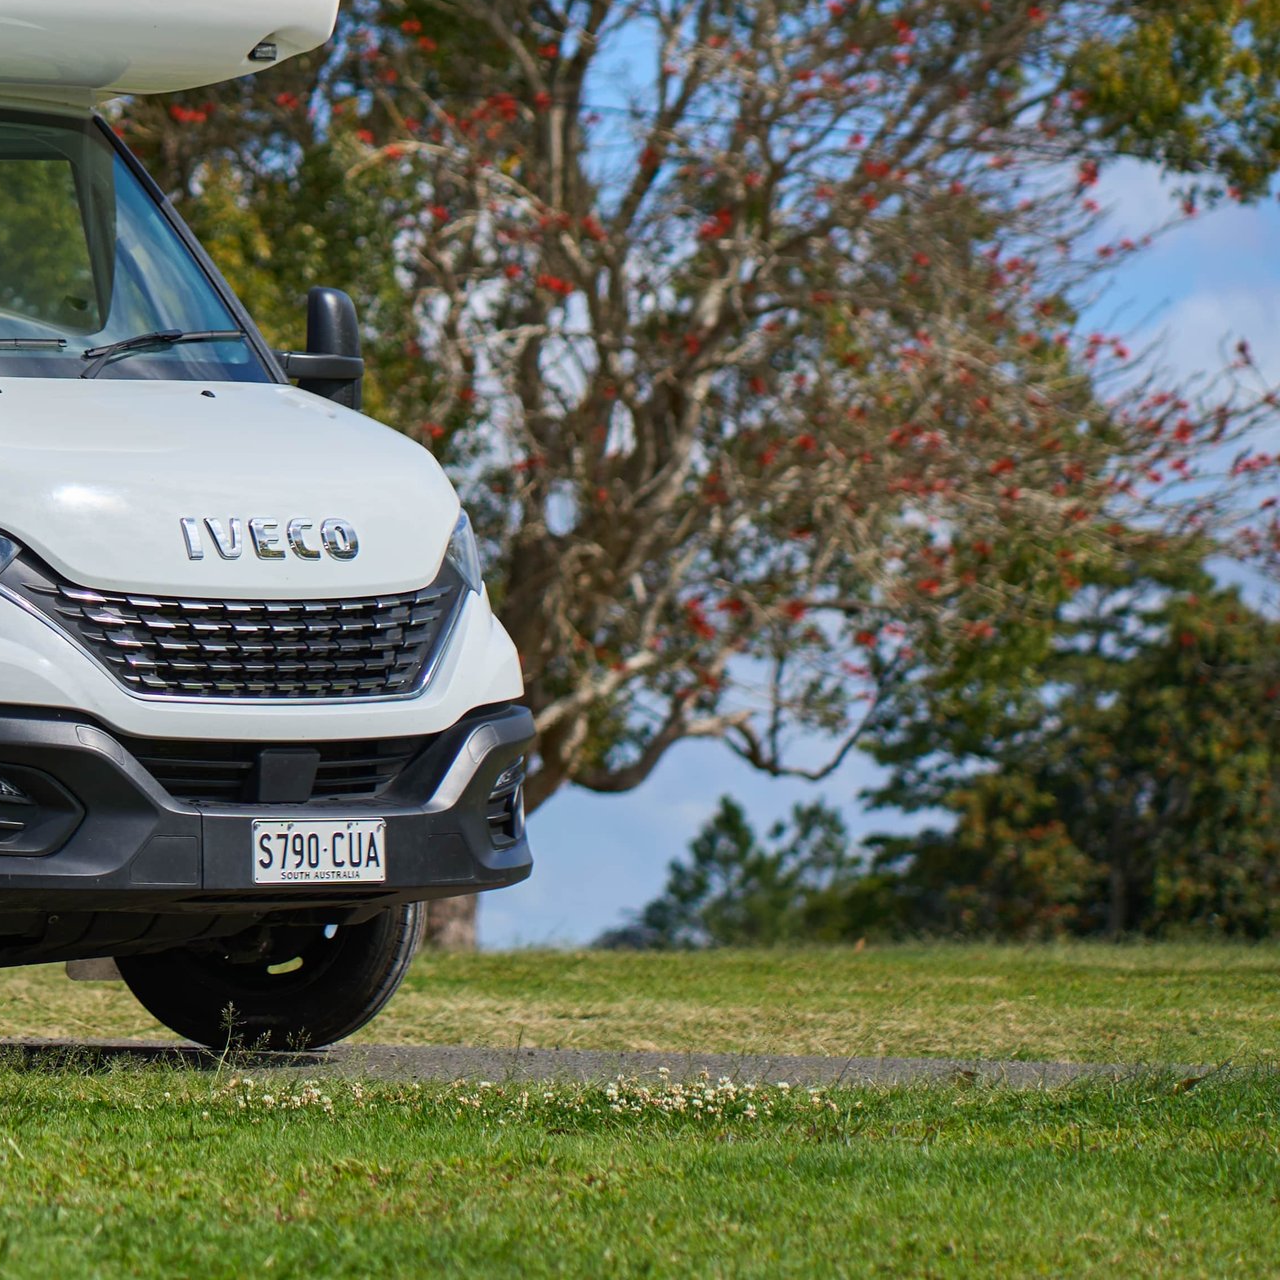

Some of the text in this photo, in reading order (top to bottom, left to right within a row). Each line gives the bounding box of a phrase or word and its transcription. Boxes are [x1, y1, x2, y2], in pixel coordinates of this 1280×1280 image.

[180, 517, 359, 561] IVECO
[281, 870, 360, 880] SOUTH AUSTRALIA
